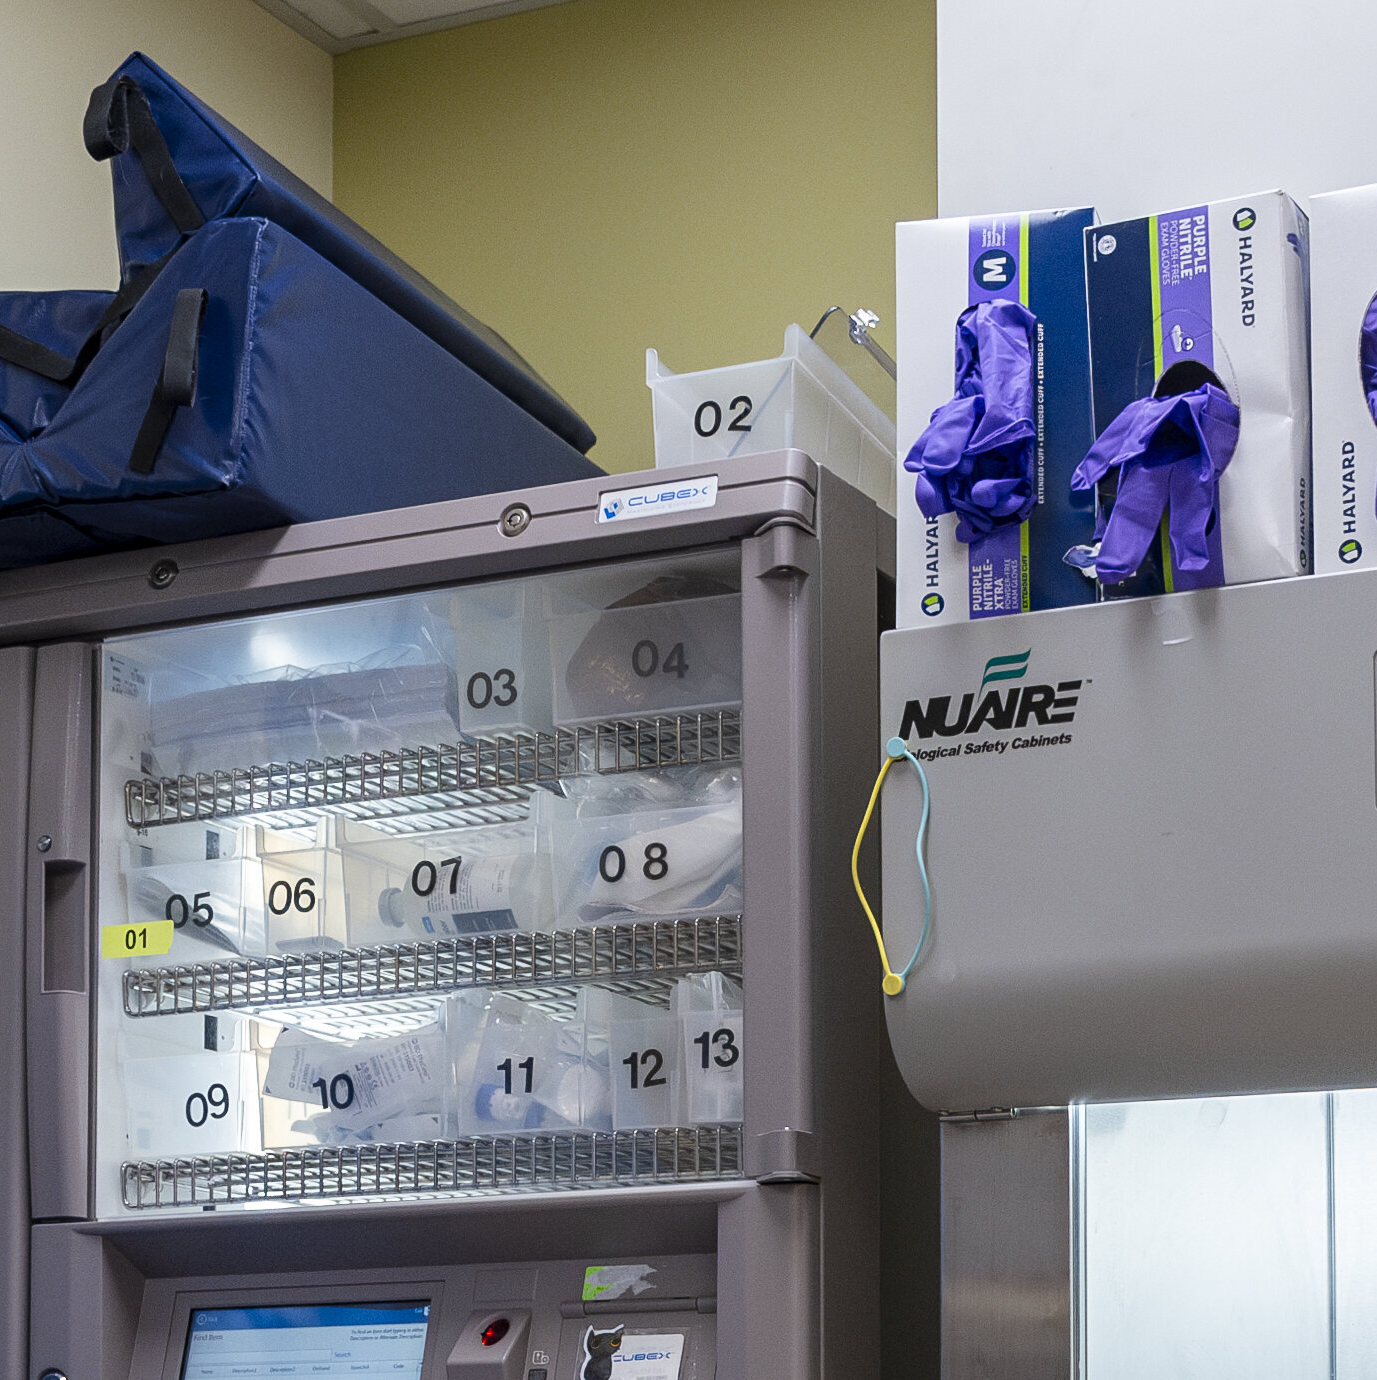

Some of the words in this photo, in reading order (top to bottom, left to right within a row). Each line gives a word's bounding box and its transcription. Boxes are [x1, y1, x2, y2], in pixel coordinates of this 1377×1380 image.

[1160, 221, 1169, 247] EXAM
[1192, 214, 1207, 275] PURPLE
[983, 257, 1006, 282] M
[1161, 249, 1171, 286] GLOVES
[1238, 237, 1255, 328] HALYARD
[694, 395, 753, 437] 02
[628, 486, 708, 507] CUBEX
[1342, 441, 1355, 534] HALYARD
[1299, 477, 1308, 544] HALYARD
[925, 514, 939, 588] HALYAR
[1021, 555, 1029, 573] CUFF
[972, 565, 982, 611] PURPLE
[1011, 559, 1019, 588] GLOVES
[1021, 574, 1029, 609] EXTENDED
[1011, 590, 1019, 610] EXAM
[632, 639, 689, 679] 04
[466, 668, 518, 709] 03
[898, 679, 1083, 741] NUAIRE
[964, 740, 1009, 756] Safety
[1011, 732, 1073, 750] Cabinets
[411, 855, 462, 897] 07
[165, 891, 214, 929] 05
[268, 877, 316, 915] 06
[125, 927, 148, 950] 01
[694, 1028, 739, 1069] 13
[497, 1057, 534, 1094] 11
[623, 1049, 666, 1089] 12
[185, 1083, 229, 1128] 09
[312, 1073, 355, 1110] 10
